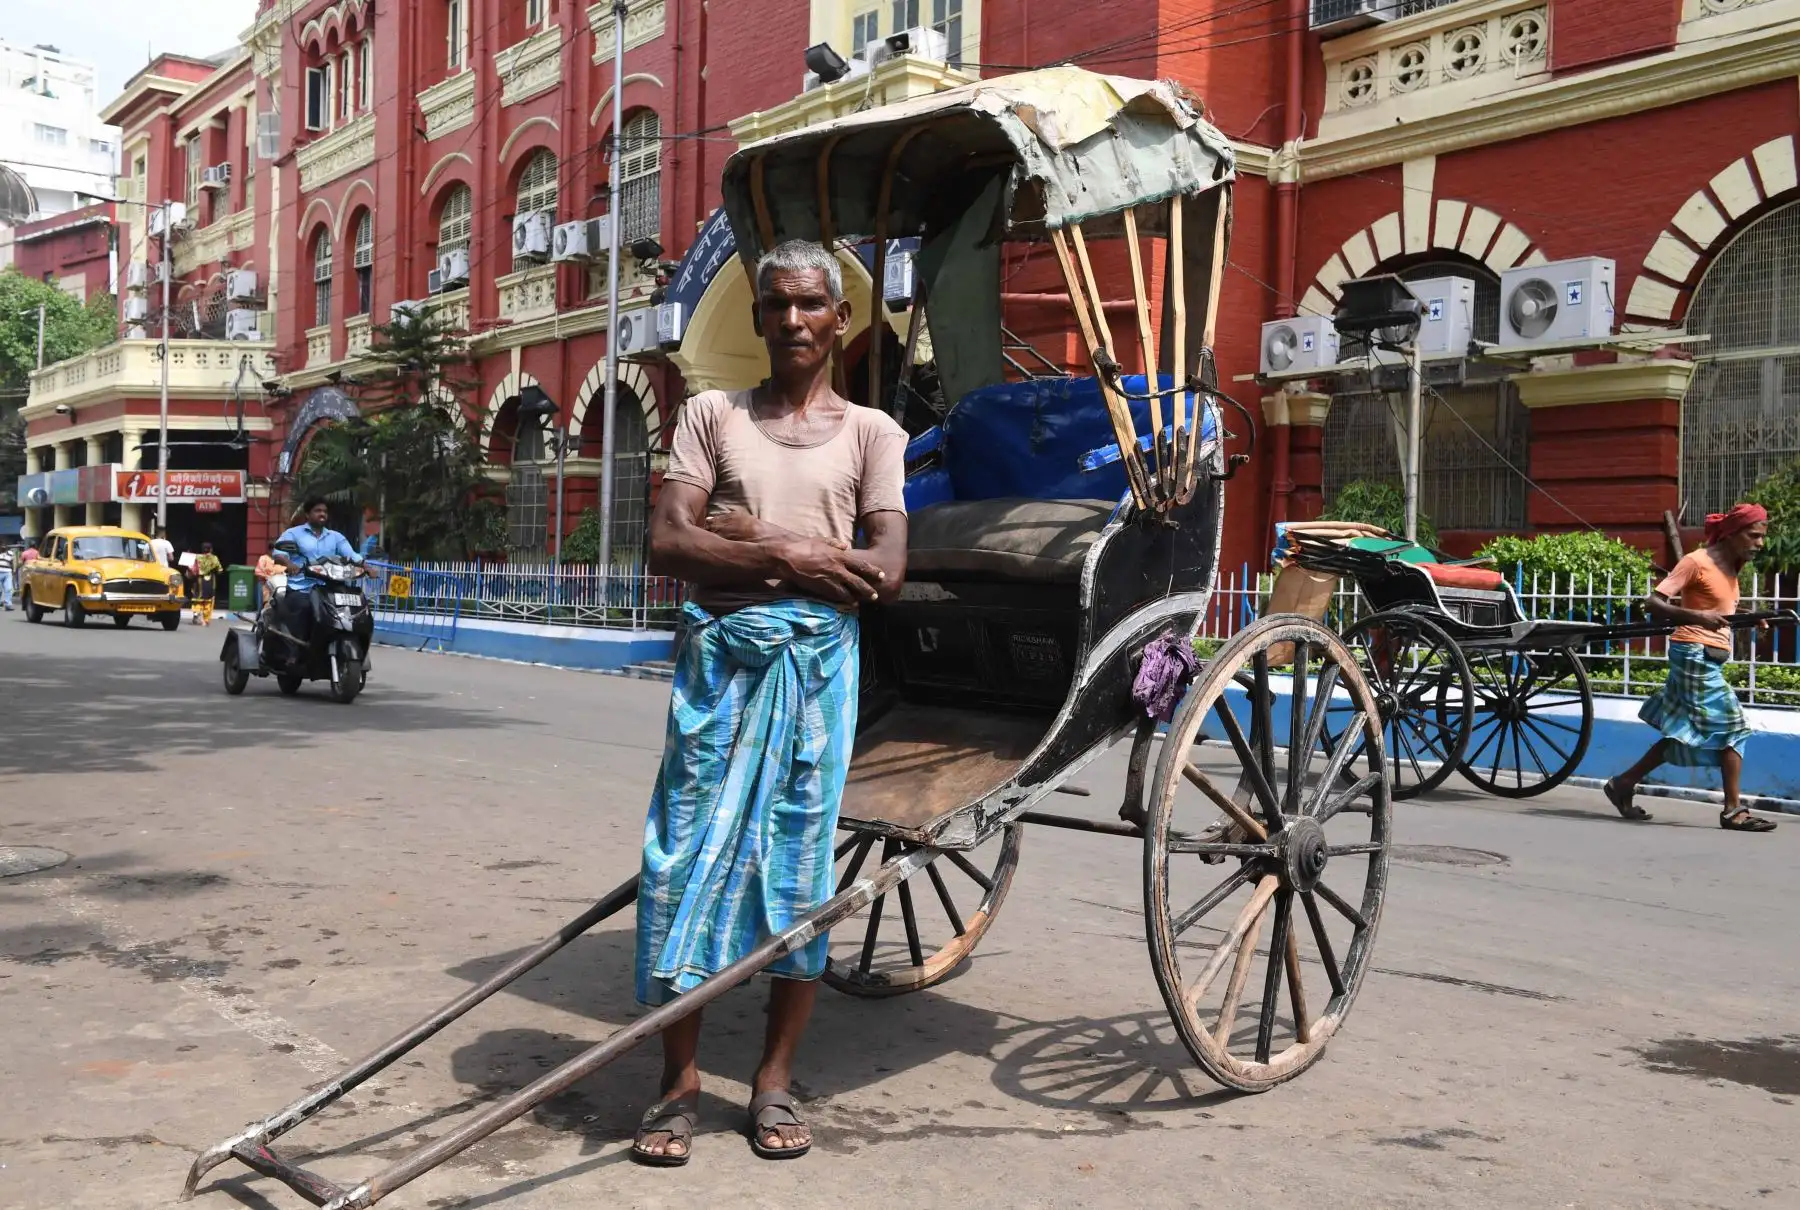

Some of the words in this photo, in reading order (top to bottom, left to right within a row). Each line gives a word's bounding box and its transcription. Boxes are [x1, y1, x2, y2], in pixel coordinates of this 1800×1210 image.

[145, 485, 181, 496] ICCI
[183, 485, 221, 496] Bank
[199, 501, 217, 510] ATM
[1013, 634, 1055, 645] RICKSHAW
